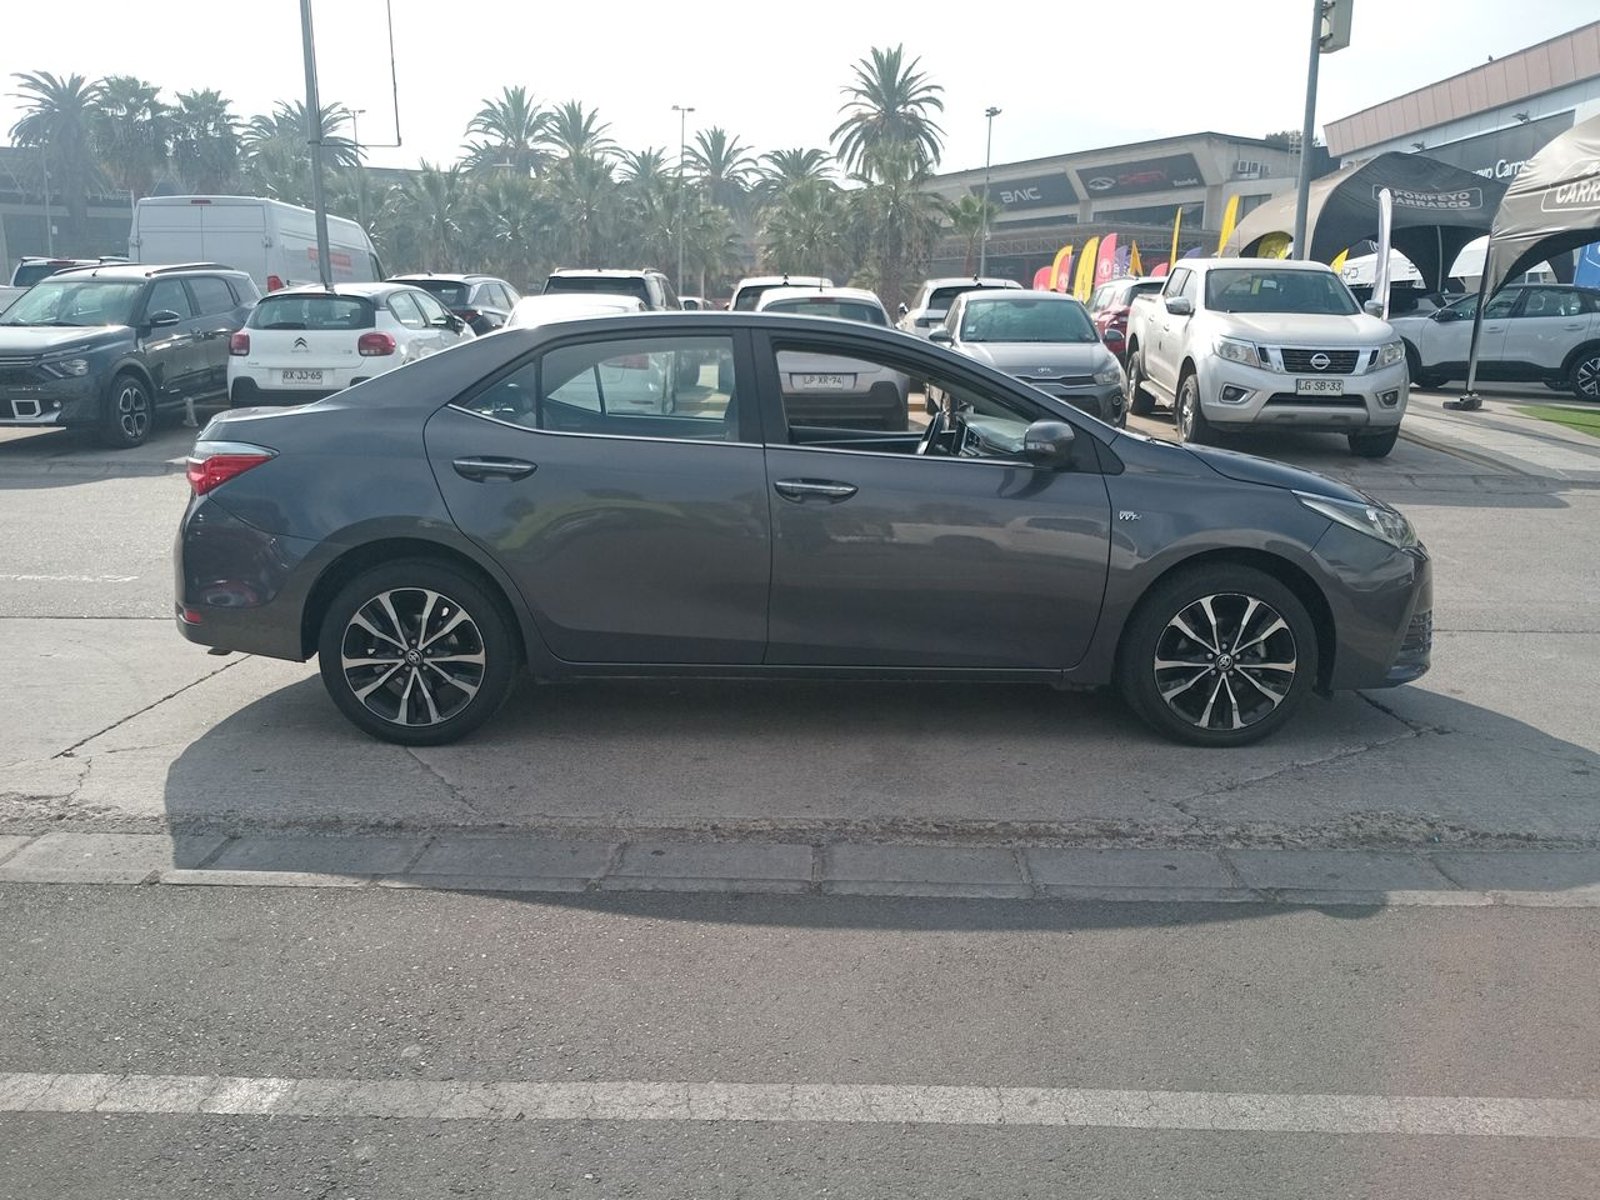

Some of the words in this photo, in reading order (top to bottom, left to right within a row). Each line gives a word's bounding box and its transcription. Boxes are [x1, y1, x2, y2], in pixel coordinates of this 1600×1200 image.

[1000, 187, 1042, 204] BAIC
[1394, 190, 1471, 201] POMPEYO
[1391, 197, 1471, 209] ARRASCO
